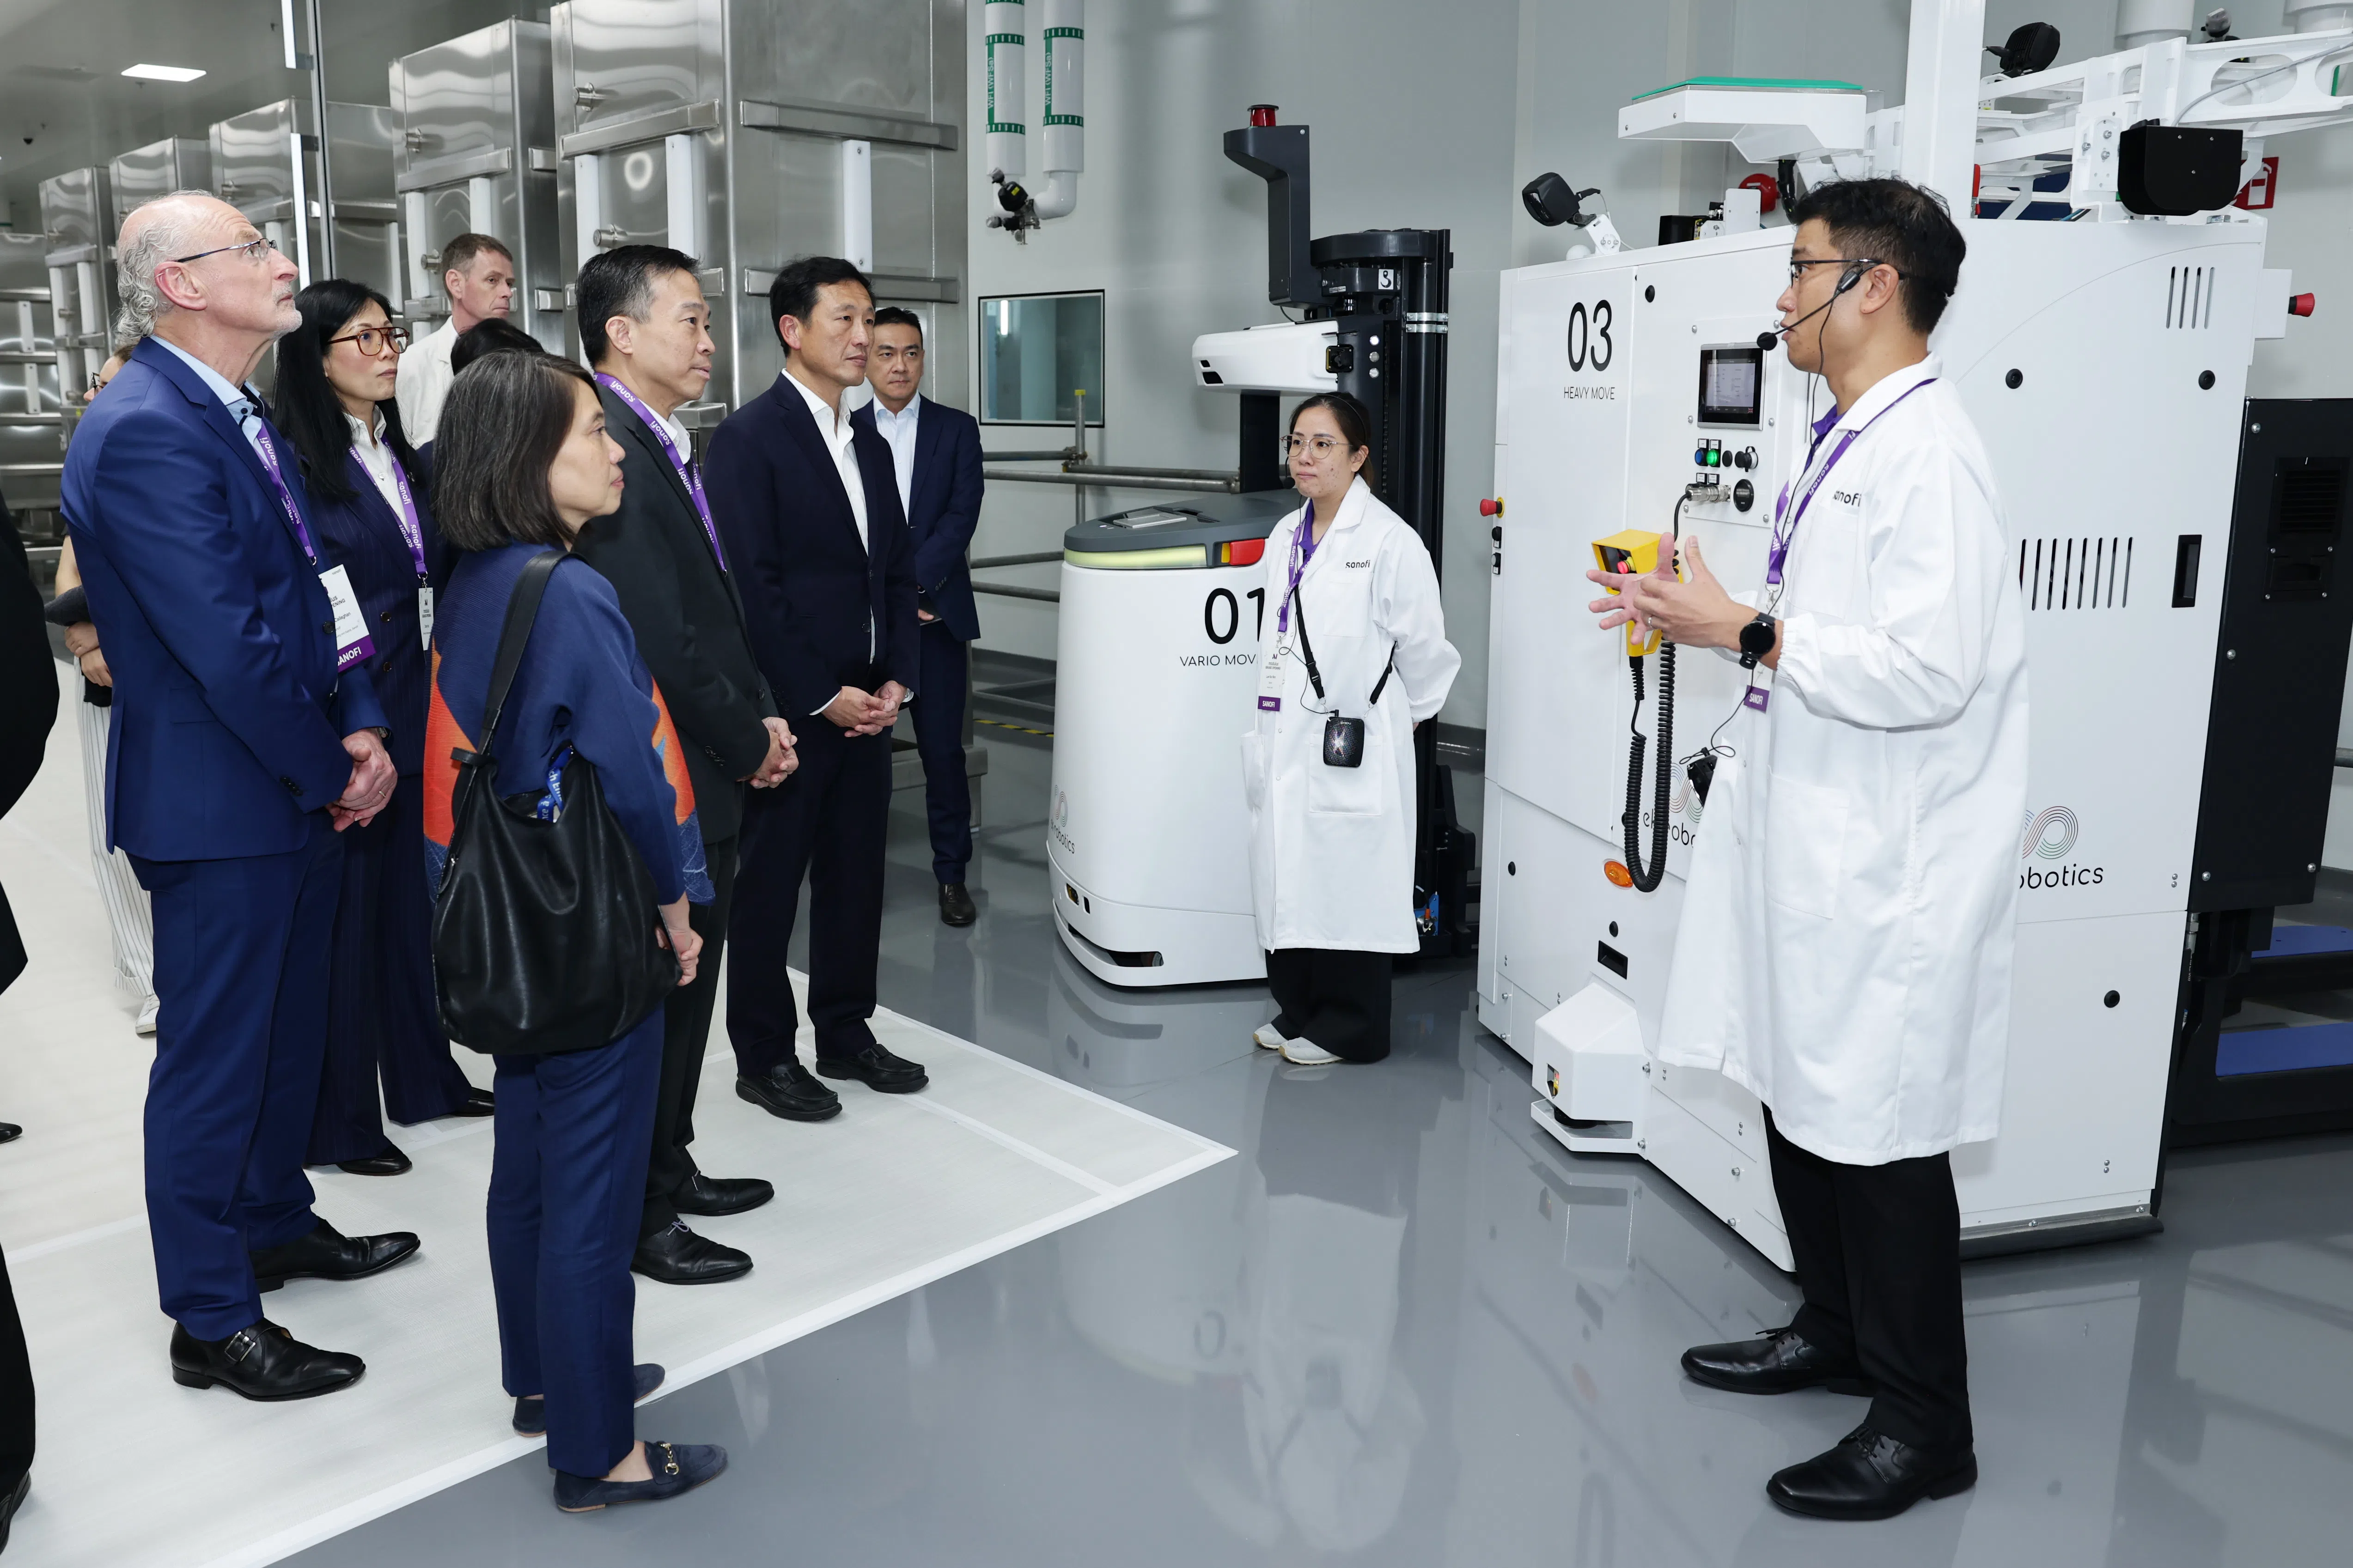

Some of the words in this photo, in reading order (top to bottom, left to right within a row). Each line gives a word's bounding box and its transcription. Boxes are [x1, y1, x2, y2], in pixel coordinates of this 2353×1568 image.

[1568, 299, 1612, 371] 03
[610, 380, 636, 402] sanofi
[1564, 386, 1589, 399] HEAVY
[1591, 386, 1615, 400] MOVE
[650, 420, 671, 445] sanofi
[259, 437, 278, 466] sanofi
[398, 481, 411, 504] sanofi
[410, 524, 421, 549] sanofi
[1345, 559, 1371, 568] sanofi
[332, 598, 346, 608] ENING
[1204, 587, 1265, 644] 01
[1180, 655, 1220, 667] VARIO
[1225, 654, 1258, 666] MOV
[1749, 693, 1763, 705] SANOFI
